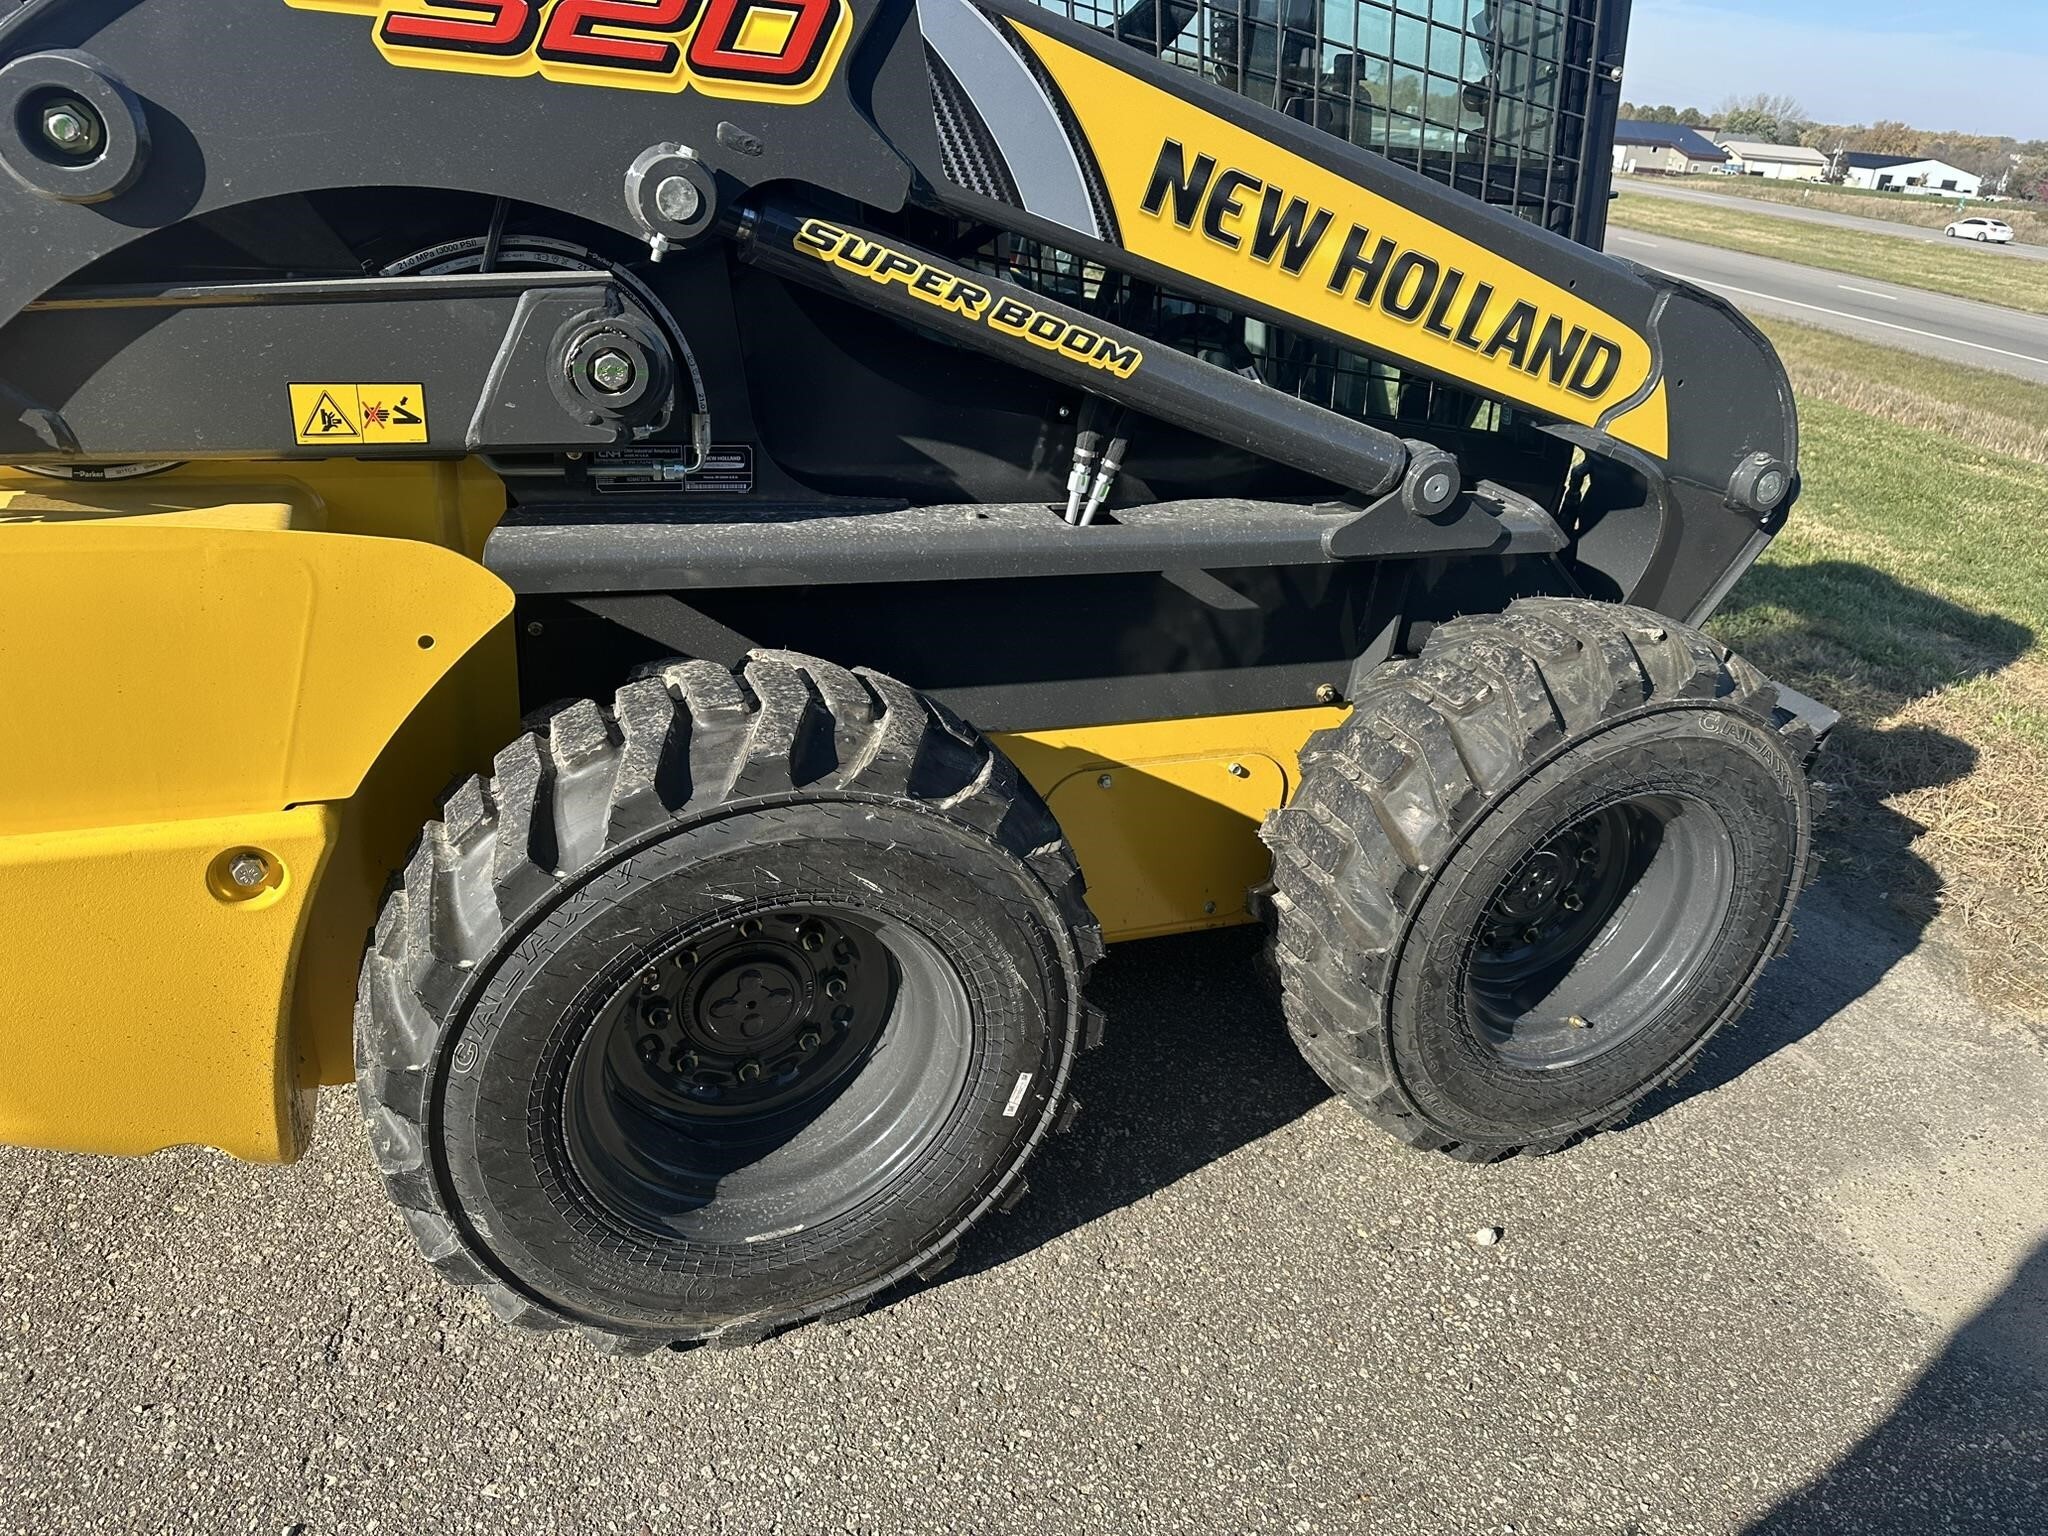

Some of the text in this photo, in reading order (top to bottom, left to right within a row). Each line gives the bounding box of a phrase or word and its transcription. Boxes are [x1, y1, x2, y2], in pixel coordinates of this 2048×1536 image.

[416, 252, 435, 267] MPa
[796, 217, 1142, 377] SUPER BOOM
[1141, 138, 1622, 400] NEW HOLLAND
[1699, 713, 1798, 803] GALAXY
[452, 858, 636, 1074] GALAXY
